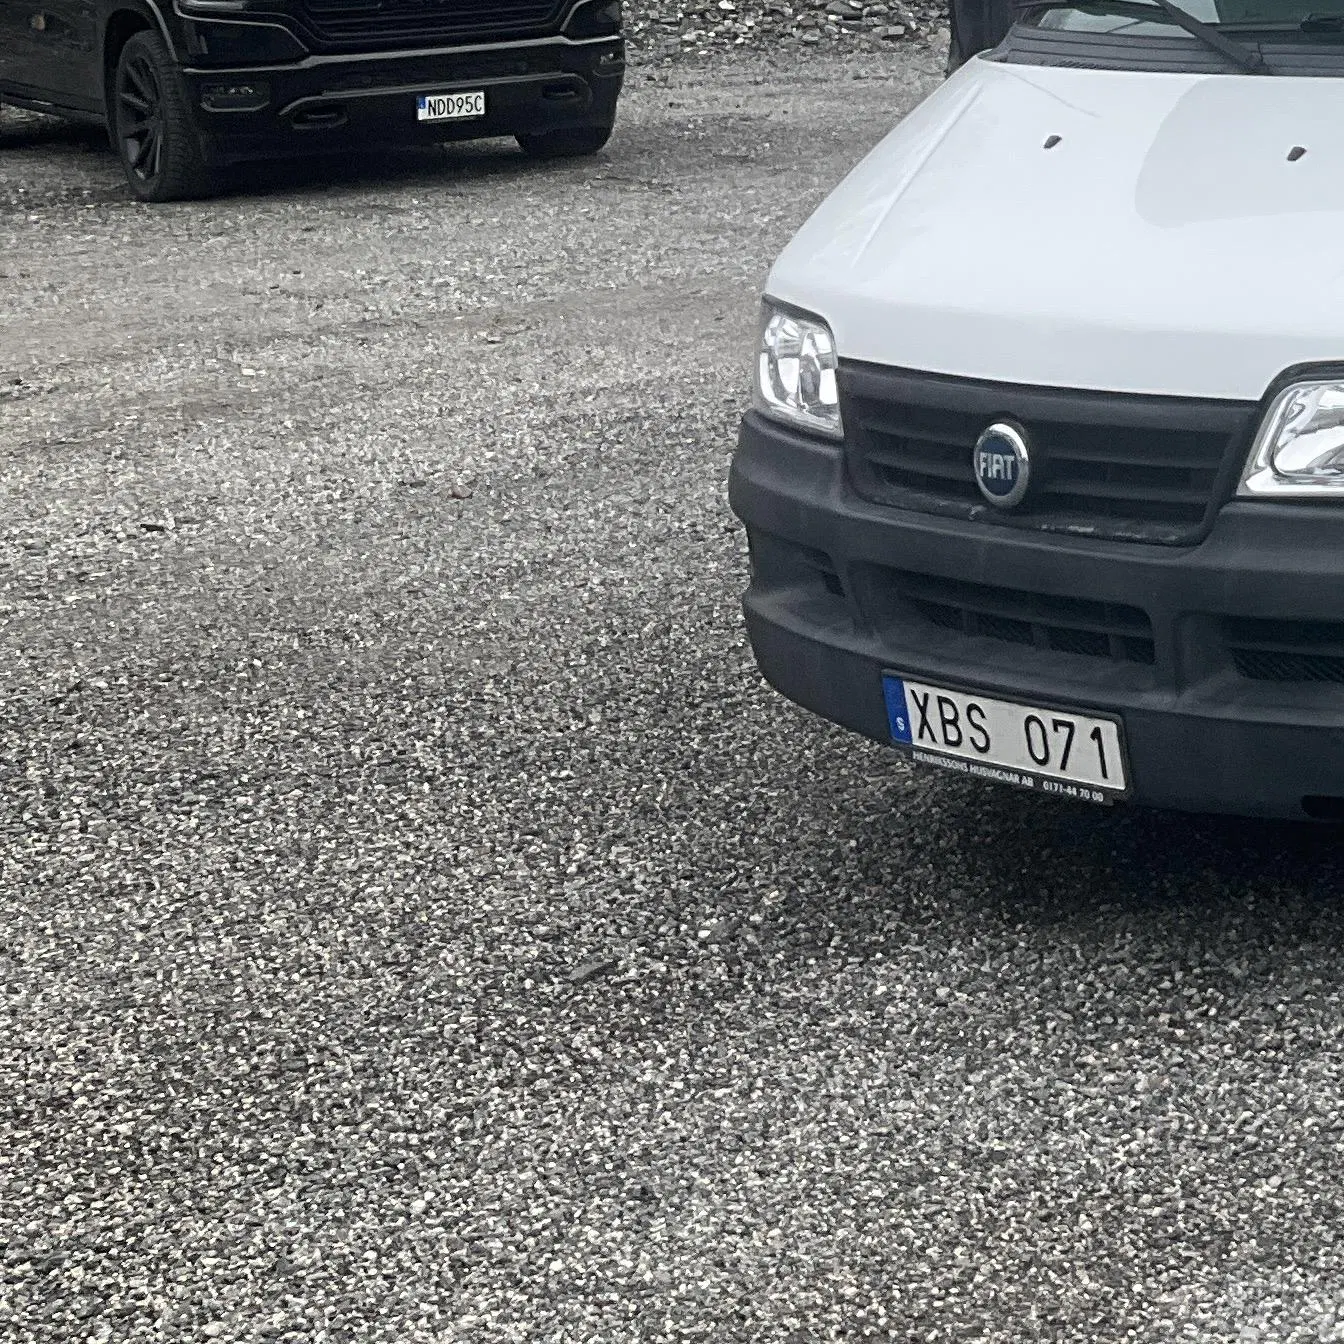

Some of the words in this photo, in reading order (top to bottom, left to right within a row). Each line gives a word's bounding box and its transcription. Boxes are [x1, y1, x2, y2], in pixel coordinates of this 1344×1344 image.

[427, 95, 482, 116] NDD95C
[980, 452, 1014, 480] FIAT
[910, 689, 991, 754] XBS
[1024, 714, 1109, 780] 071
[969, 764, 1020, 784] HUSVAGNAR
[1021, 776, 1034, 787] AB
